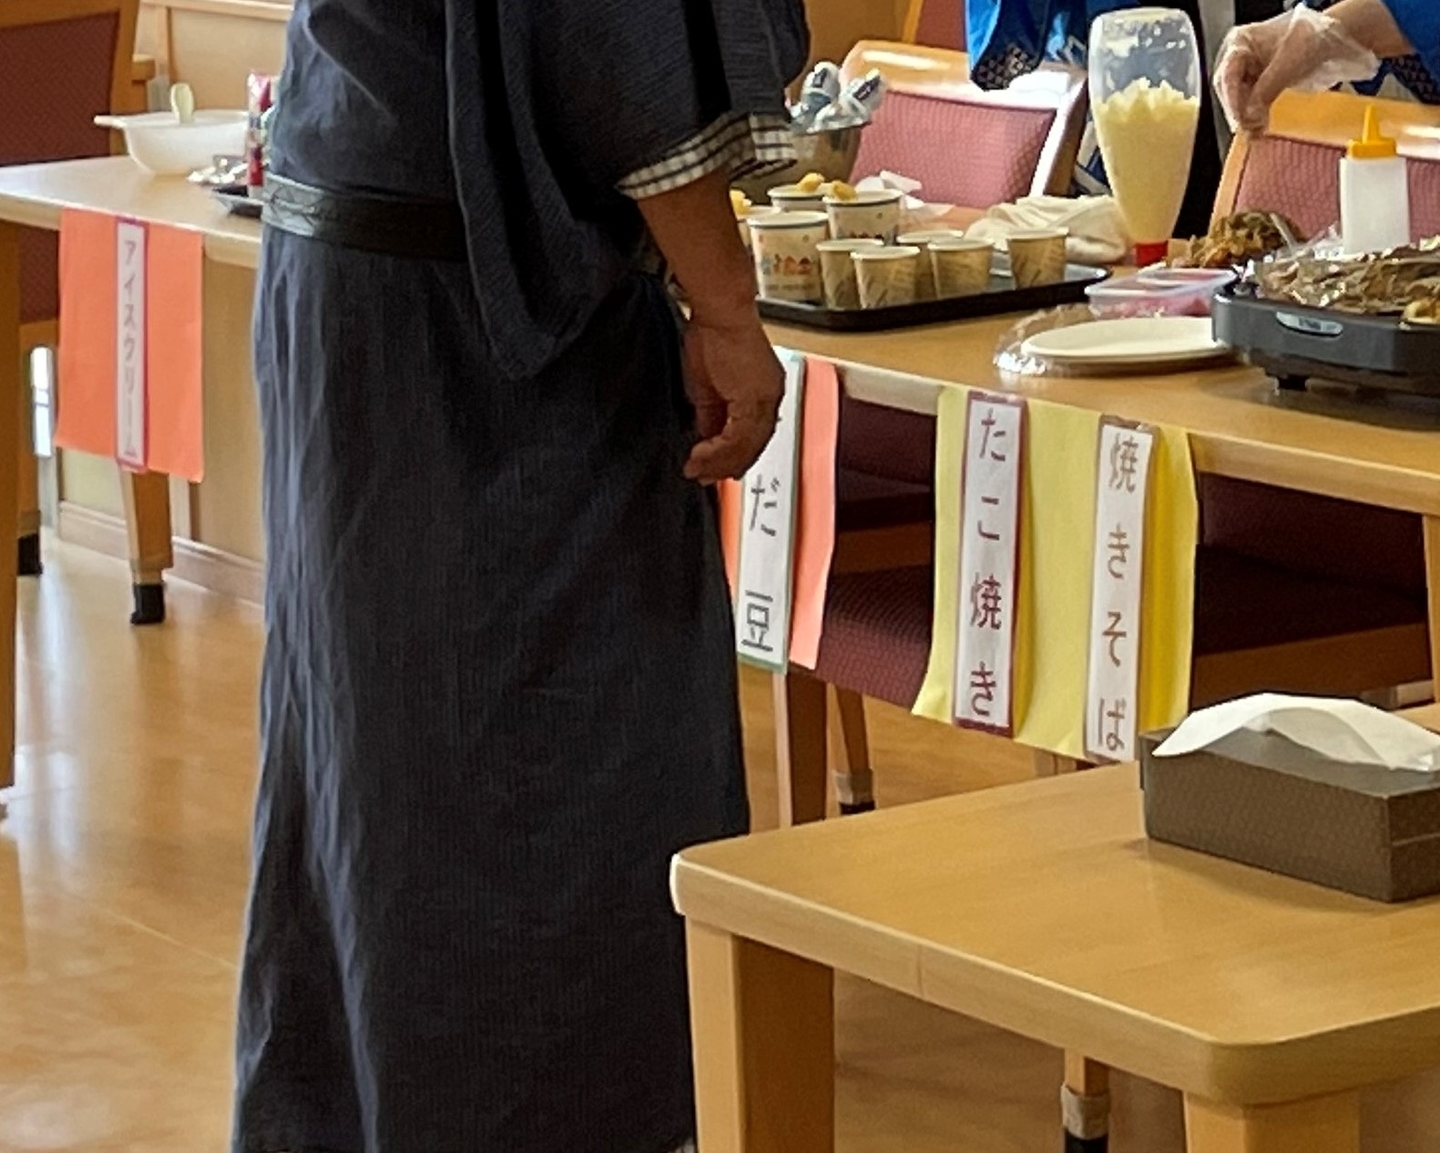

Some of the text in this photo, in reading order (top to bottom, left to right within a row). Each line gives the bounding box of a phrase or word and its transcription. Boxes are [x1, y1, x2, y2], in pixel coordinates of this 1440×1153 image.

[122, 239, 138, 459] アイスクリーム
[741, 415, 785, 653] だ豆
[970, 407, 1007, 718] たこ焼き
[1100, 433, 1138, 751] 焼きそば
